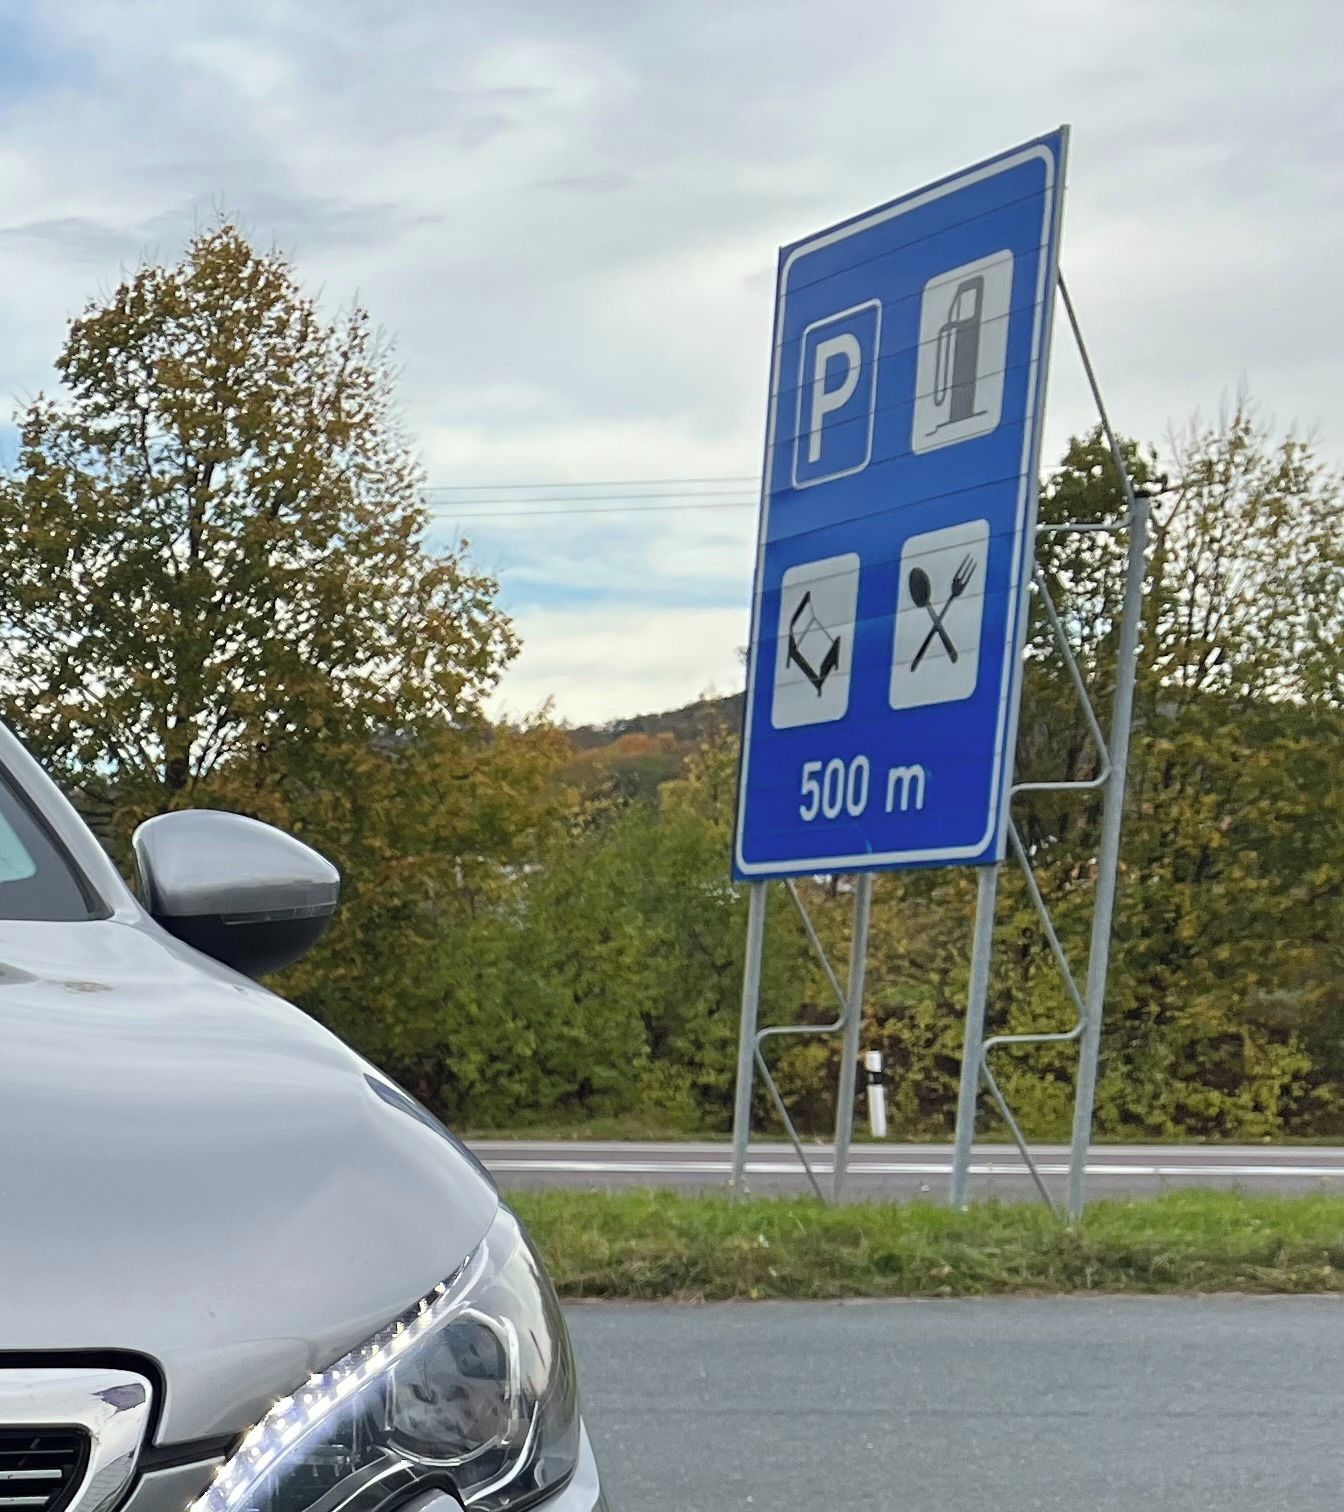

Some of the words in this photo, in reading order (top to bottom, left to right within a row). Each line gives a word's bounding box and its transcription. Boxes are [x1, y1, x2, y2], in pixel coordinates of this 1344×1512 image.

[808, 332, 863, 463] P
[799, 754, 870, 822] 500
[885, 761, 925, 813] m
